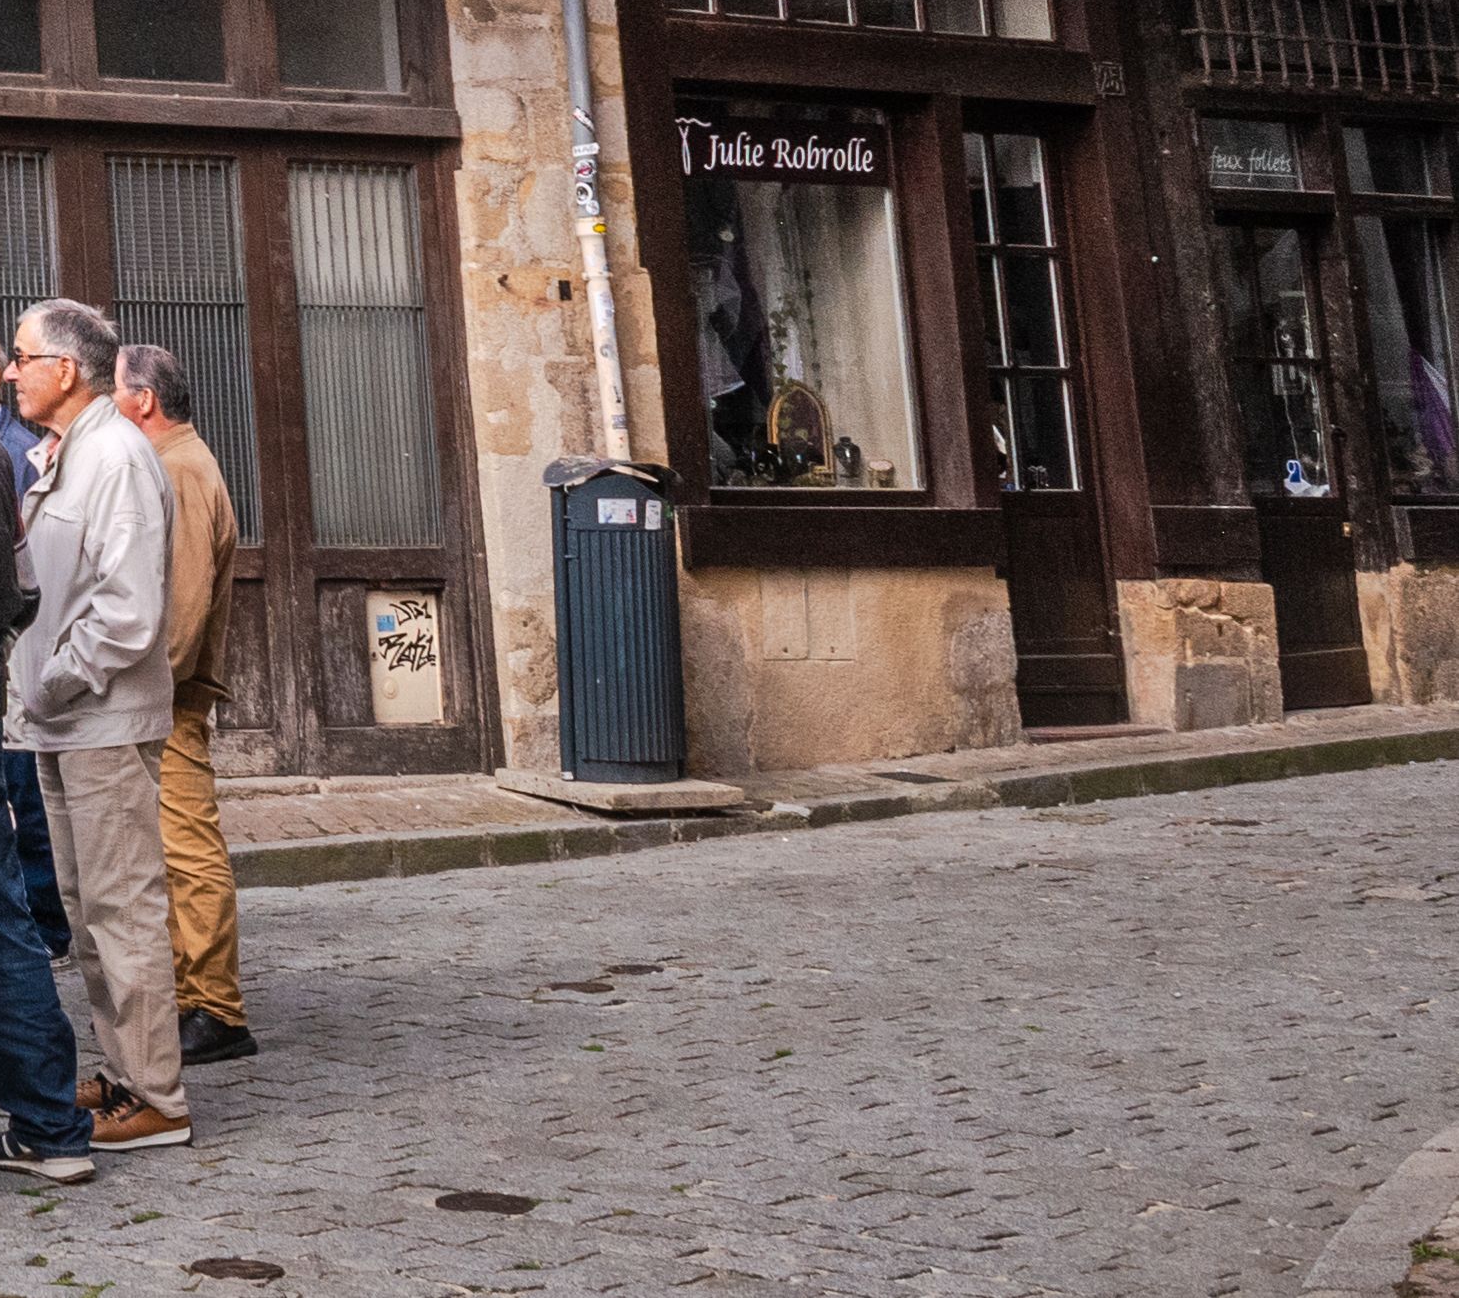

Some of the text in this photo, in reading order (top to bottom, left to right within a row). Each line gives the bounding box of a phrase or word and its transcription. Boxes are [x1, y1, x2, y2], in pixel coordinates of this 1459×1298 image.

[704, 131, 875, 173] Julie Robrolle
[1247, 147, 1292, 183] follets
